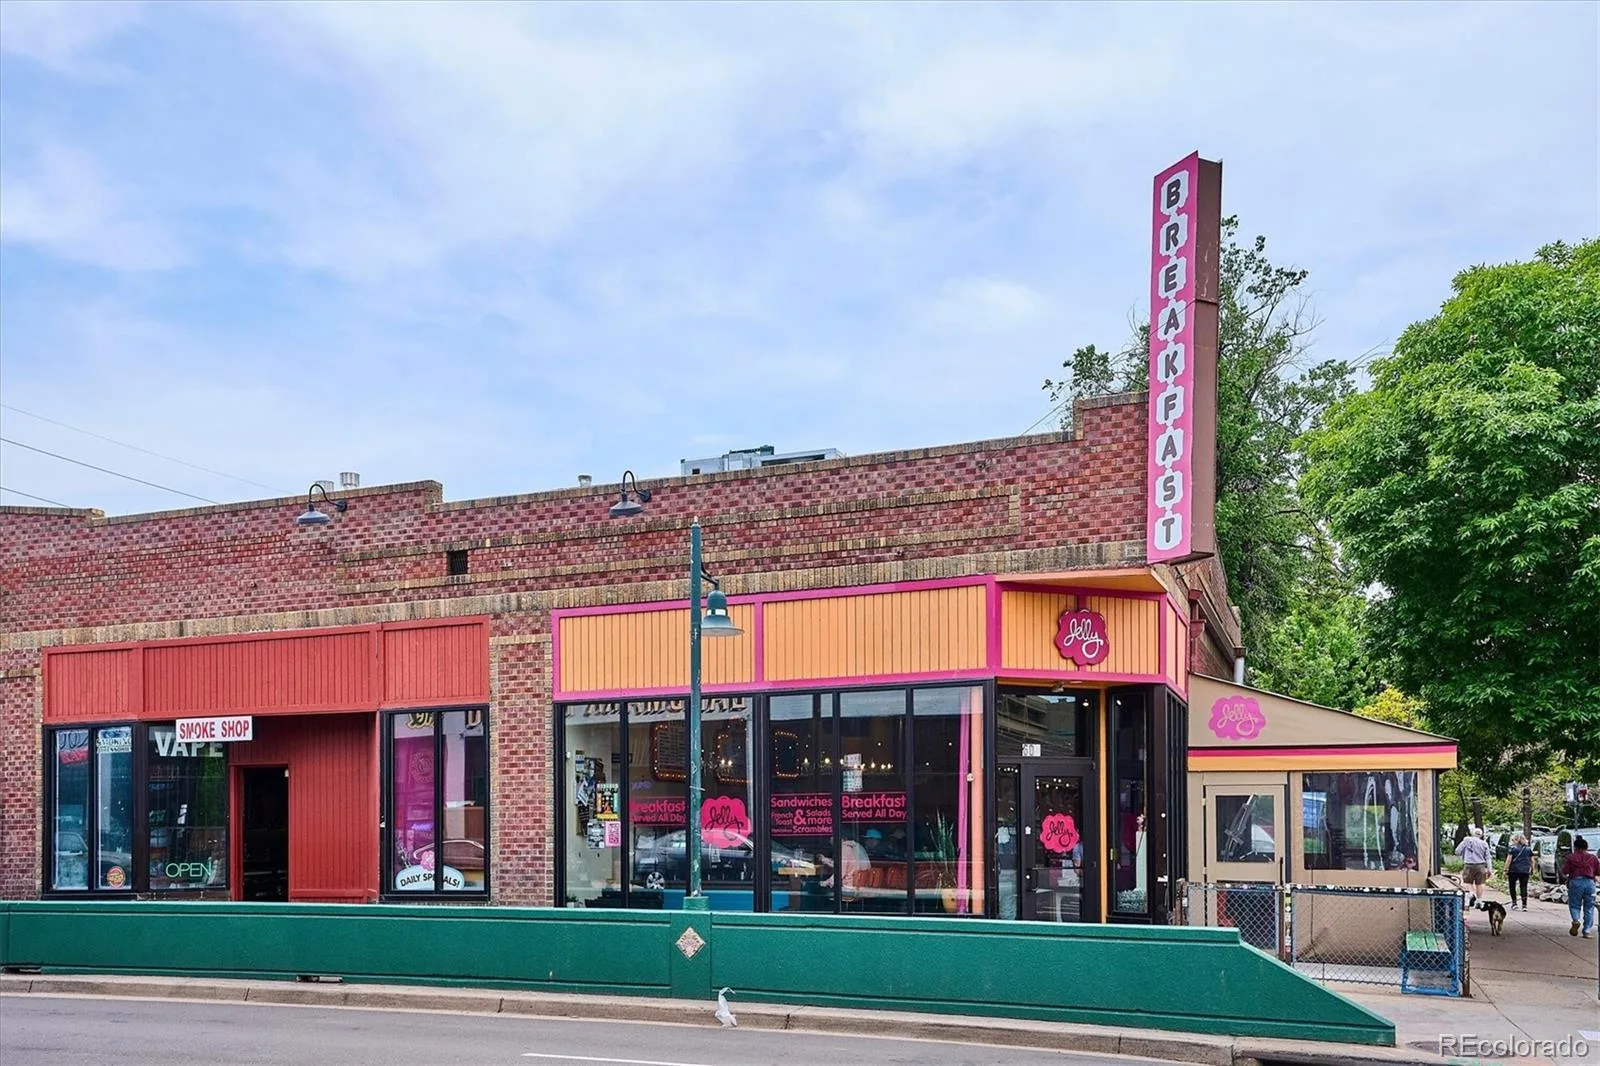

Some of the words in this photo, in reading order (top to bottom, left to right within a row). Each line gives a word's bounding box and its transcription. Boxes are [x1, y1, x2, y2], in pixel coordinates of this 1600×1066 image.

[1161, 178, 1181, 545] BREAKFAST
[1064, 618, 1104, 658] Jelly
[1217, 704, 1257, 736] Jelly
[180, 722, 215, 739] SMOKE
[221, 720, 249, 737] SHOP
[155, 732, 223, 757] VAPE
[771, 796, 833, 808] Sandwiches
[842, 794, 907, 808] Breakfast
[658, 813, 669, 821] All
[794, 809, 807, 825] &
[808, 817, 833, 825] more
[806, 809, 831, 817] Salads
[842, 810, 873, 818] Served
[875, 809, 886, 818] All
[888, 809, 907, 819] Day
[704, 806, 744, 841] Jelly
[793, 825, 833, 833] Scrambles
[1046, 820, 1073, 847] Jelly
[165, 862, 212, 878] OPEN
[400, 874, 420, 887] DAILY
[423, 873, 460, 889] SPALS!
